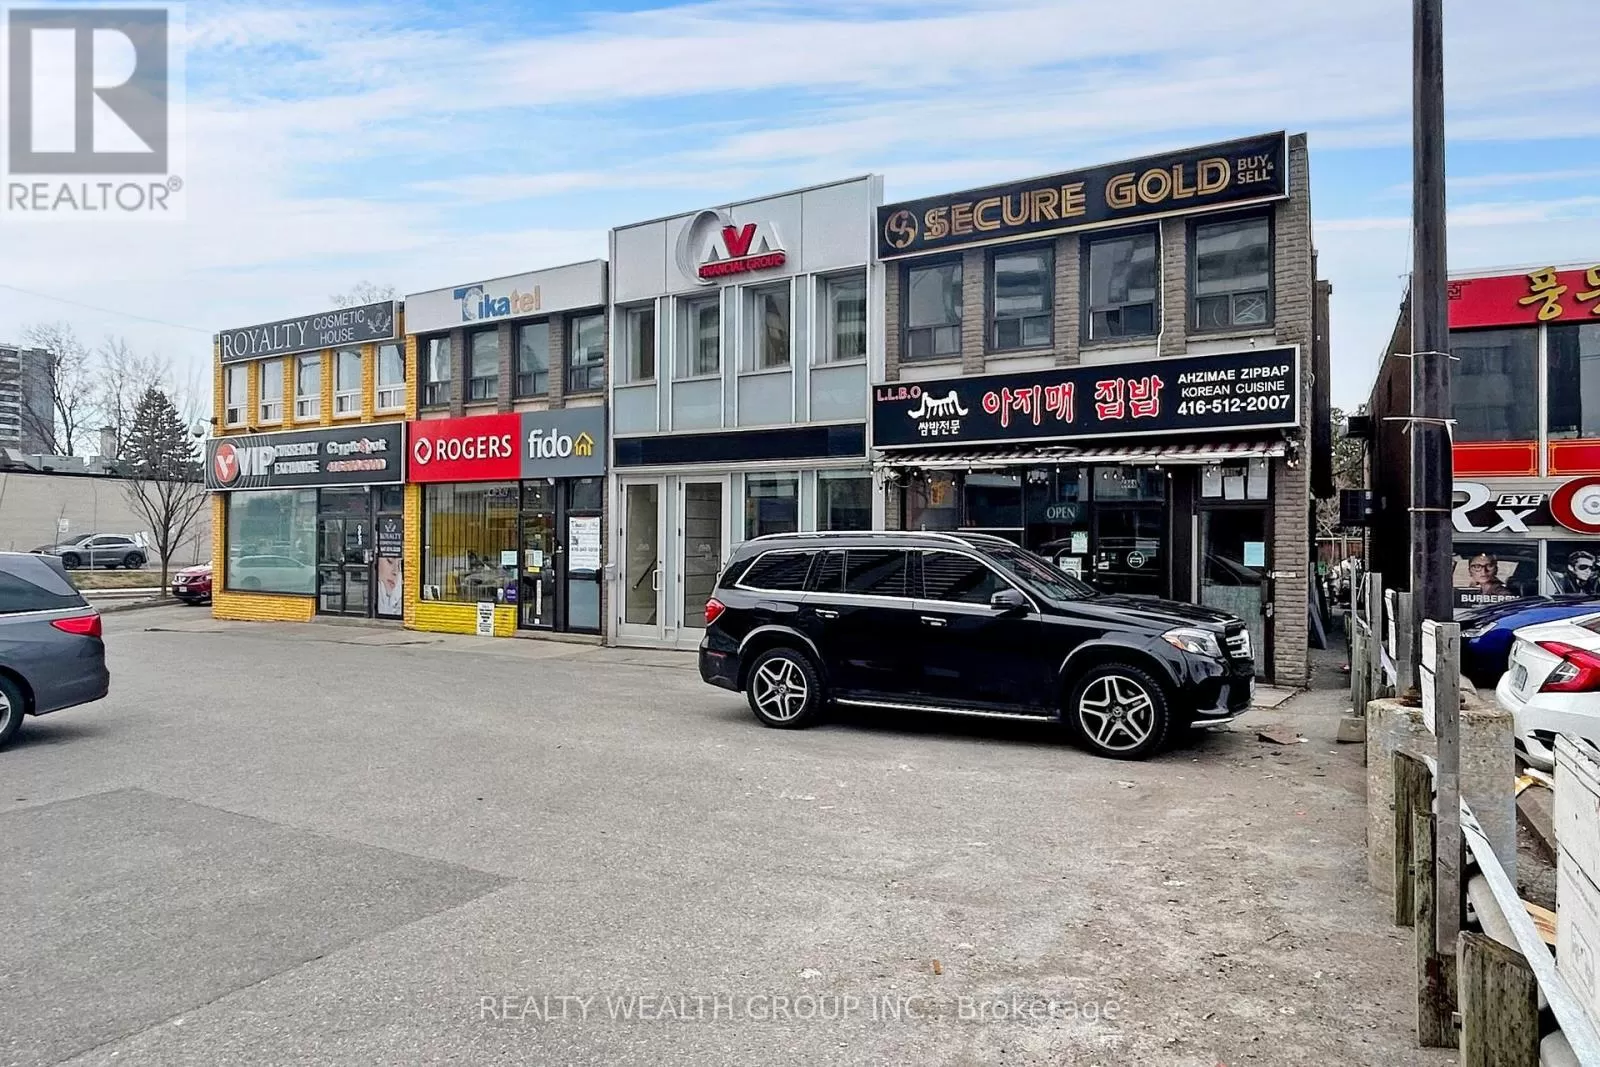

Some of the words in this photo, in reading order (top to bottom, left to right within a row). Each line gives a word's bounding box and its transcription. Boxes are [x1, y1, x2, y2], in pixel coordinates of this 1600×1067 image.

[1237, 154, 1269, 171] BUY
[1237, 168, 1271, 184] SELL
[923, 181, 1086, 241] SECURE
[1105, 157, 1231, 210] GOLD
[453, 284, 541, 321] Tikatel
[222, 320, 309, 359] ROYALTY
[313, 309, 365, 331] COSMETIC
[320, 327, 354, 345] HOUSE
[1177, 369, 1236, 385] AHZIMAE
[1240, 365, 1290, 380] ZIPBAP
[1181, 383, 1231, 398] KOREAN
[1235, 380, 1285, 394] CUISINE
[982, 382, 1075, 428] 아지매
[1094, 375, 1164, 420] 집밥
[1177, 394, 1291, 416] 416-512-2007
[918, 419, 961, 437] 쌈밥전문
[436, 434, 513, 461] ROGERS
[527, 428, 573, 459] fido
[235, 445, 275, 476] VIP
[1499, 494, 1541, 505] EYE
[1046, 506, 1075, 519] OPEN
